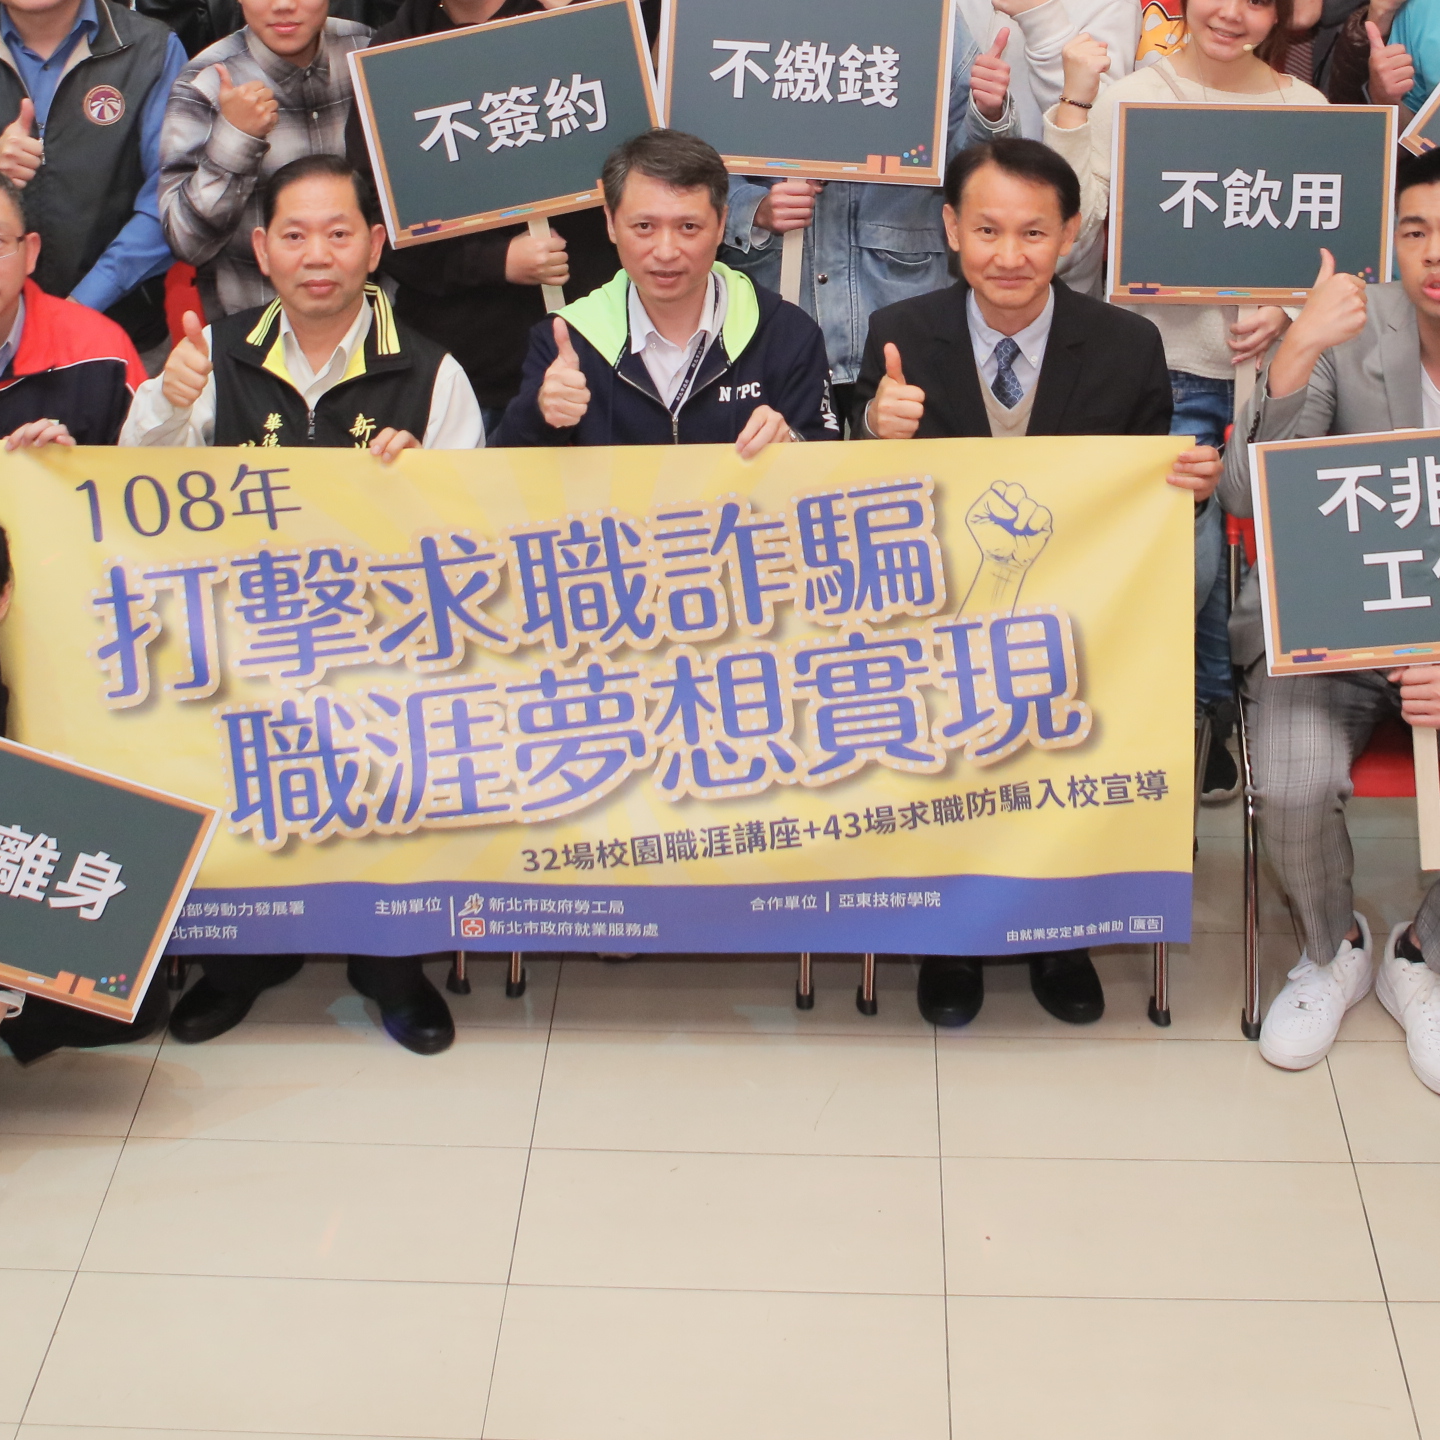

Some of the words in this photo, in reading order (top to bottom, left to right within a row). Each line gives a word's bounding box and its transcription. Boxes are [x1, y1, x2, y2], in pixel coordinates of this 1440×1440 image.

[709, 38, 900, 109] 不繳錢
[414, 73, 608, 162] 不簽約
[1159, 167, 1343, 231] 不飲用
[74, 462, 303, 546] 108年
[95, 475, 942, 705] 打擊求職詐騙
[220, 610, 1088, 846] 職涯夢想實現
[521, 766, 1170, 876] 32場校園職涯講座+43場求職防騙入校宣導
[374, 895, 443, 915] 主辦單位
[488, 896, 625, 915] 新北市政府勞工局
[750, 893, 818, 911] 合作單位
[838, 891, 942, 909] 亞東技術學院
[488, 919, 659, 938] 新北市政府就業服務處
[1006, 919, 1124, 943] 由就業安定基金補助
[1132, 917, 1160, 932] 廣告
